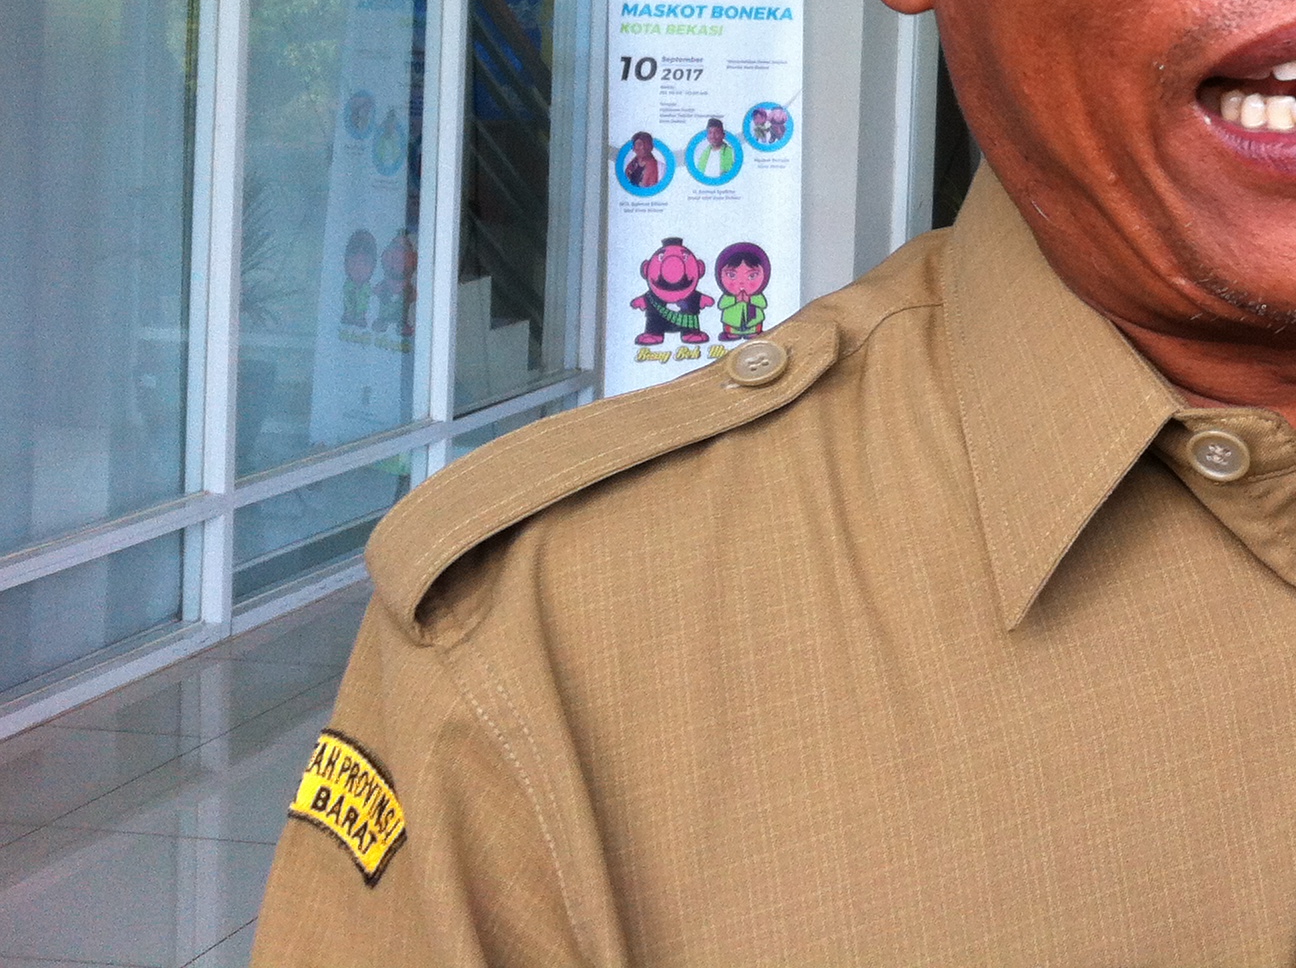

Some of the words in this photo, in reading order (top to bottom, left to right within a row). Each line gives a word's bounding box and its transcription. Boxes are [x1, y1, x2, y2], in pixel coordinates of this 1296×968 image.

[621, 3, 707, 18] MASKOT
[711, 5, 793, 20] BONEKA
[620, 22, 661, 35] KOTA
[665, 24, 724, 37] BEKASI
[620, 56, 657, 81] 10
[661, 68, 703, 81] 2017
[336, 755, 401, 845] PROVINSI
[310, 786, 378, 855] BARAT
